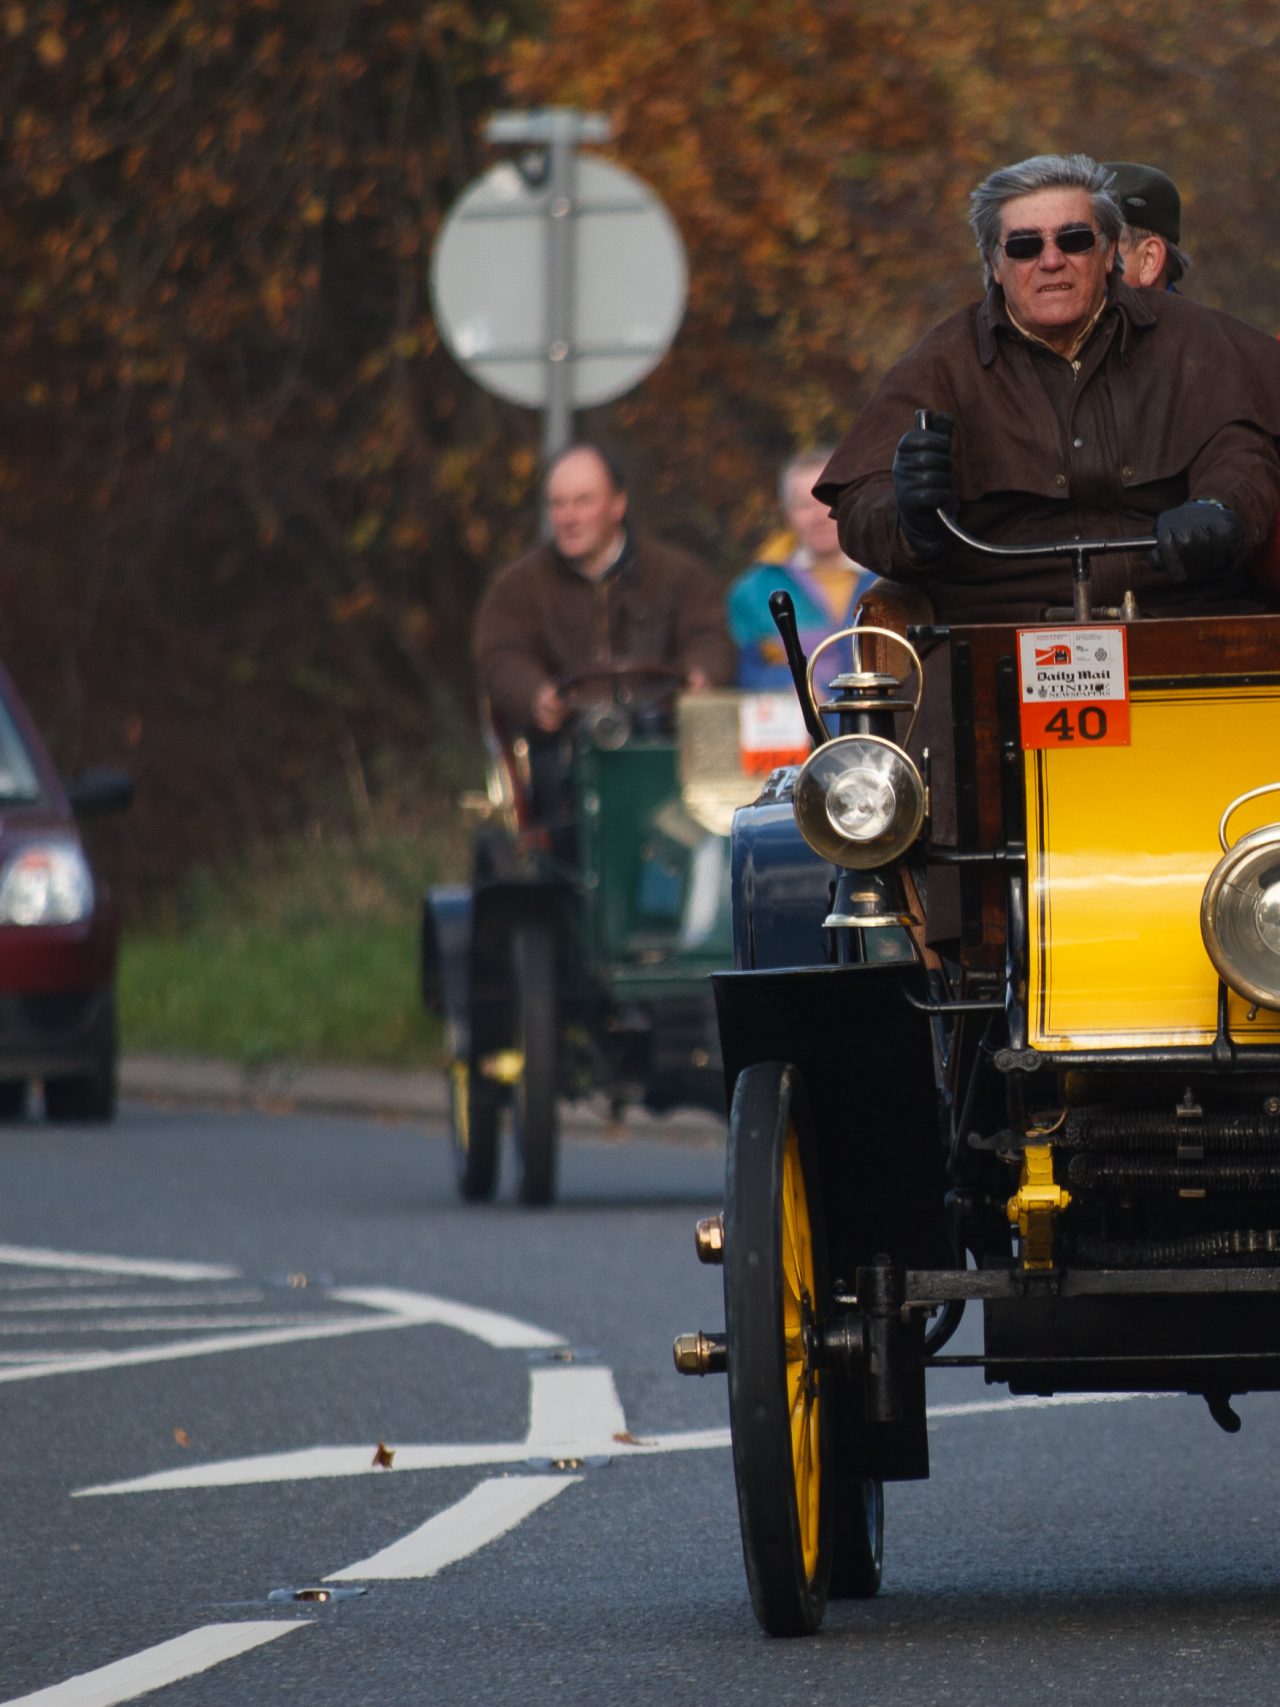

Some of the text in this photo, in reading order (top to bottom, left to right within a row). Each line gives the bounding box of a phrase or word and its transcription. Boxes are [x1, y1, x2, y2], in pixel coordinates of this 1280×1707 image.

[1037, 670, 1111, 683] Daily Mail
[1045, 706, 1107, 741] 40
